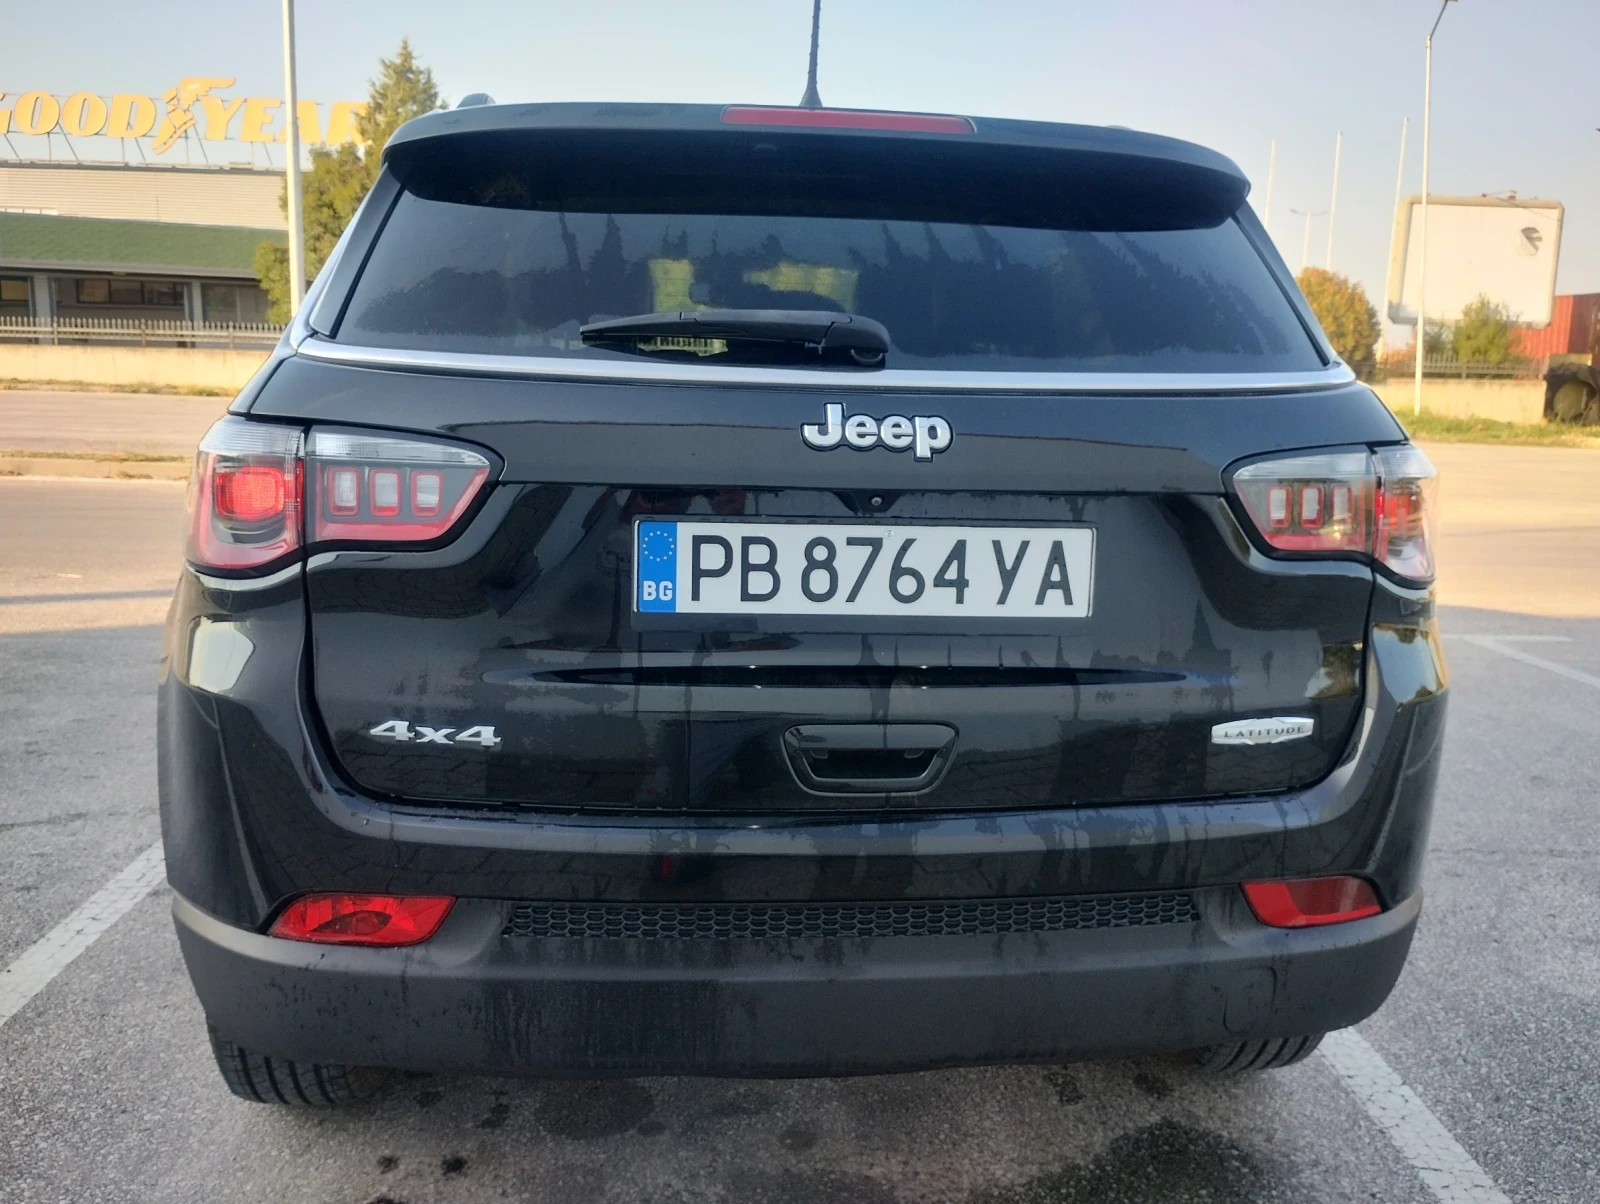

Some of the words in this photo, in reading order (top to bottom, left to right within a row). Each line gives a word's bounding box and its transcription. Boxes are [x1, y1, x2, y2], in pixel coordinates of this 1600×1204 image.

[803, 403, 953, 459] Jeep
[691, 534, 781, 603] PB
[800, 535, 970, 605] 8764
[991, 539, 1075, 606] YA
[642, 580, 674, 601] BG
[369, 720, 502, 746] 4x4
[1224, 725, 1305, 738] LATITUDE
